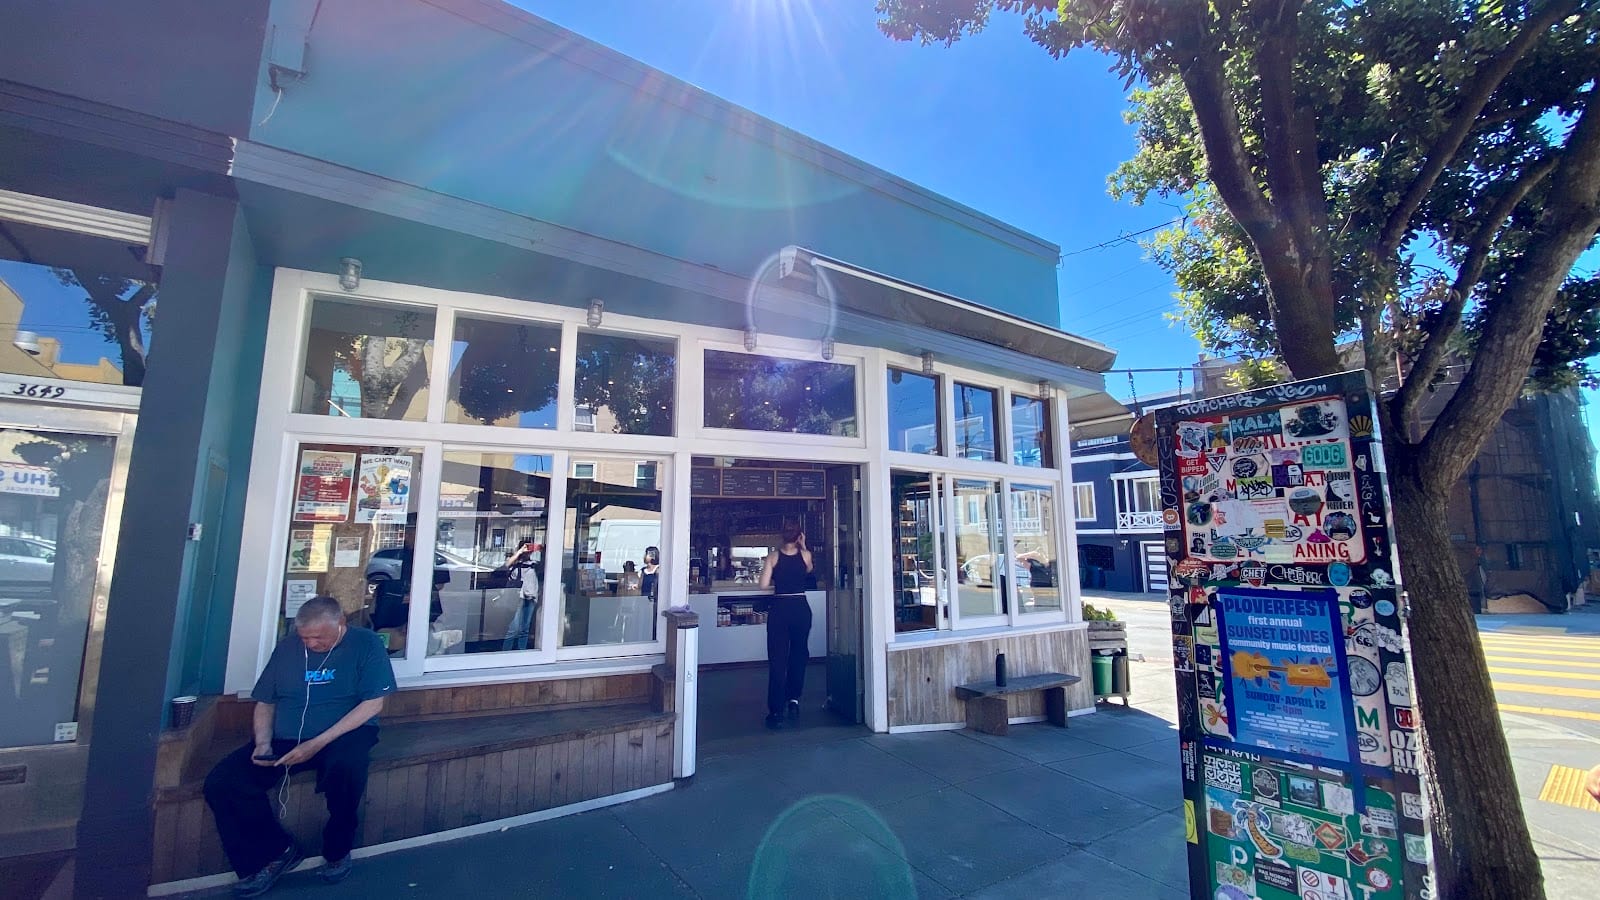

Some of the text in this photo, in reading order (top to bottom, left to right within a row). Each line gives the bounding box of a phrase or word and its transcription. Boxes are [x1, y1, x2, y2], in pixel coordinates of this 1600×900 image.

[13, 383, 65, 398] 3649
[1232, 412, 1281, 433] KALX
[1243, 569, 1265, 578] CHET
[1223, 598, 1327, 617] PLOVERFEST
[1248, 615, 1303, 628] first annual
[1228, 625, 1330, 644] SUNSET DUNES
[1228, 639, 1331, 654] community music festival
[305, 668, 336, 682] PEAK
[1245, 690, 1326, 709] SUNDAY APRIL 12
